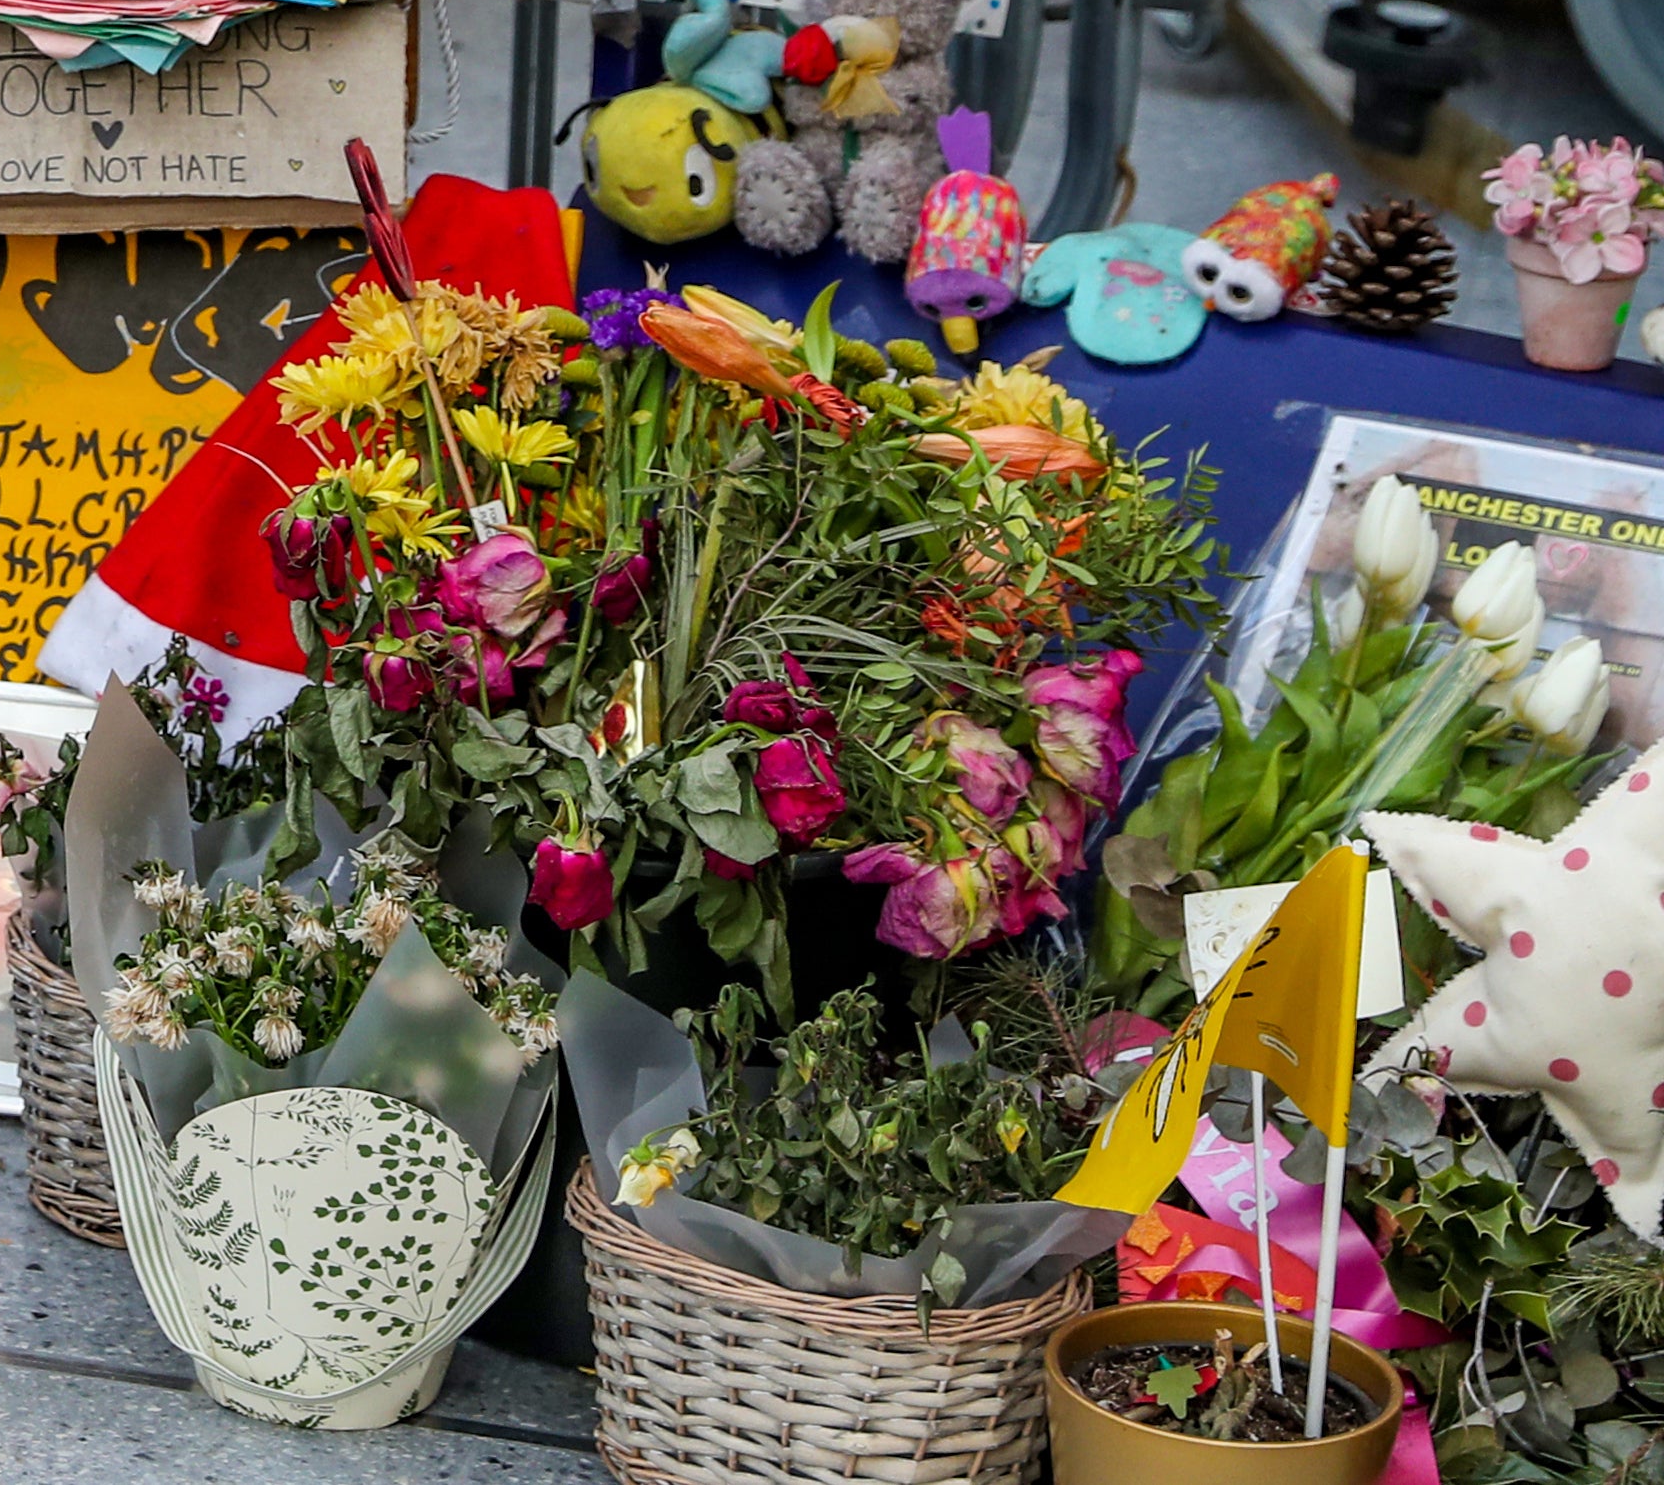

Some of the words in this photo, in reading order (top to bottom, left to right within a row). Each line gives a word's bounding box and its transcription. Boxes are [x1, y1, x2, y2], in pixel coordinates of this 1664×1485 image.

[83, 156, 145, 185] NOT
[162, 156, 248, 185] HATE
[1407, 481, 1602, 539] ANCHESTER
